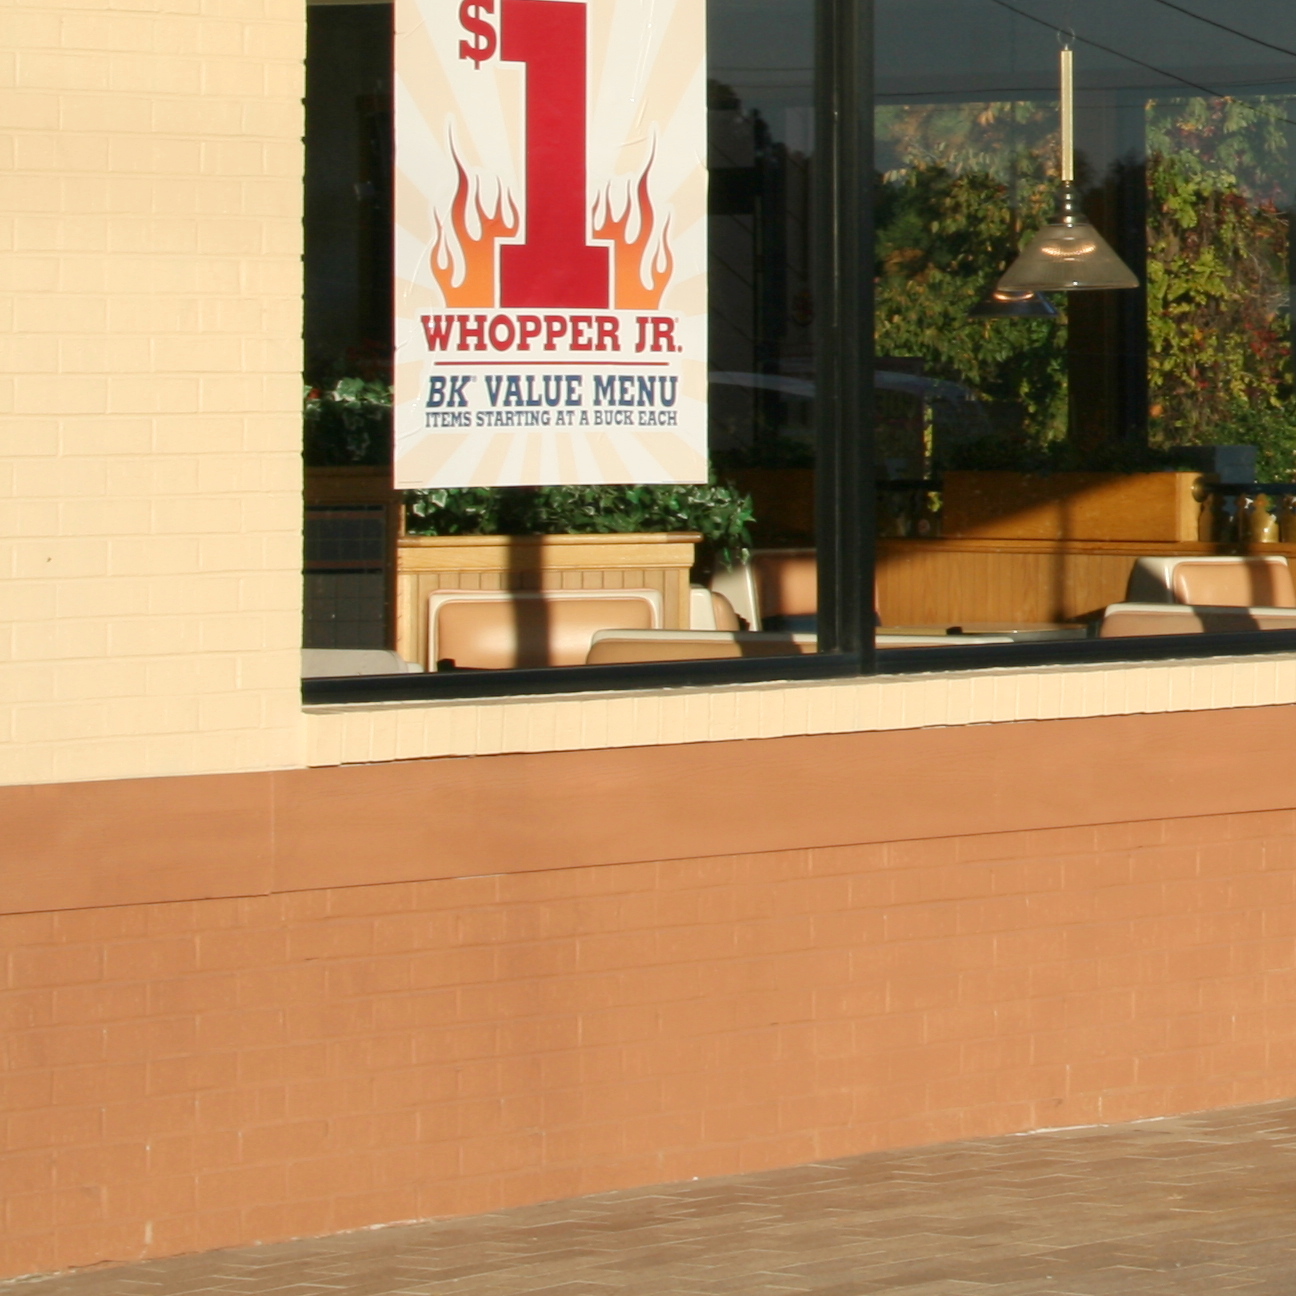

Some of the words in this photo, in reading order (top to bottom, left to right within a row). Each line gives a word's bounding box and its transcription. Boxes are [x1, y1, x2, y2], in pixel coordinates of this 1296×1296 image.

[420, 313, 621, 352] WHOPPER
[634, 315, 684, 354] JR.
[425, 374, 475, 408] BK
[484, 374, 583, 407] VALUE
[592, 374, 679, 407] MENU
[425, 410, 472, 428] ITEMS
[475, 409, 552, 427] STARTING
[554, 409, 576, 426] AT
[578, 409, 590, 426] A
[593, 409, 635, 426] BUCK
[637, 410, 678, 426] EACH
